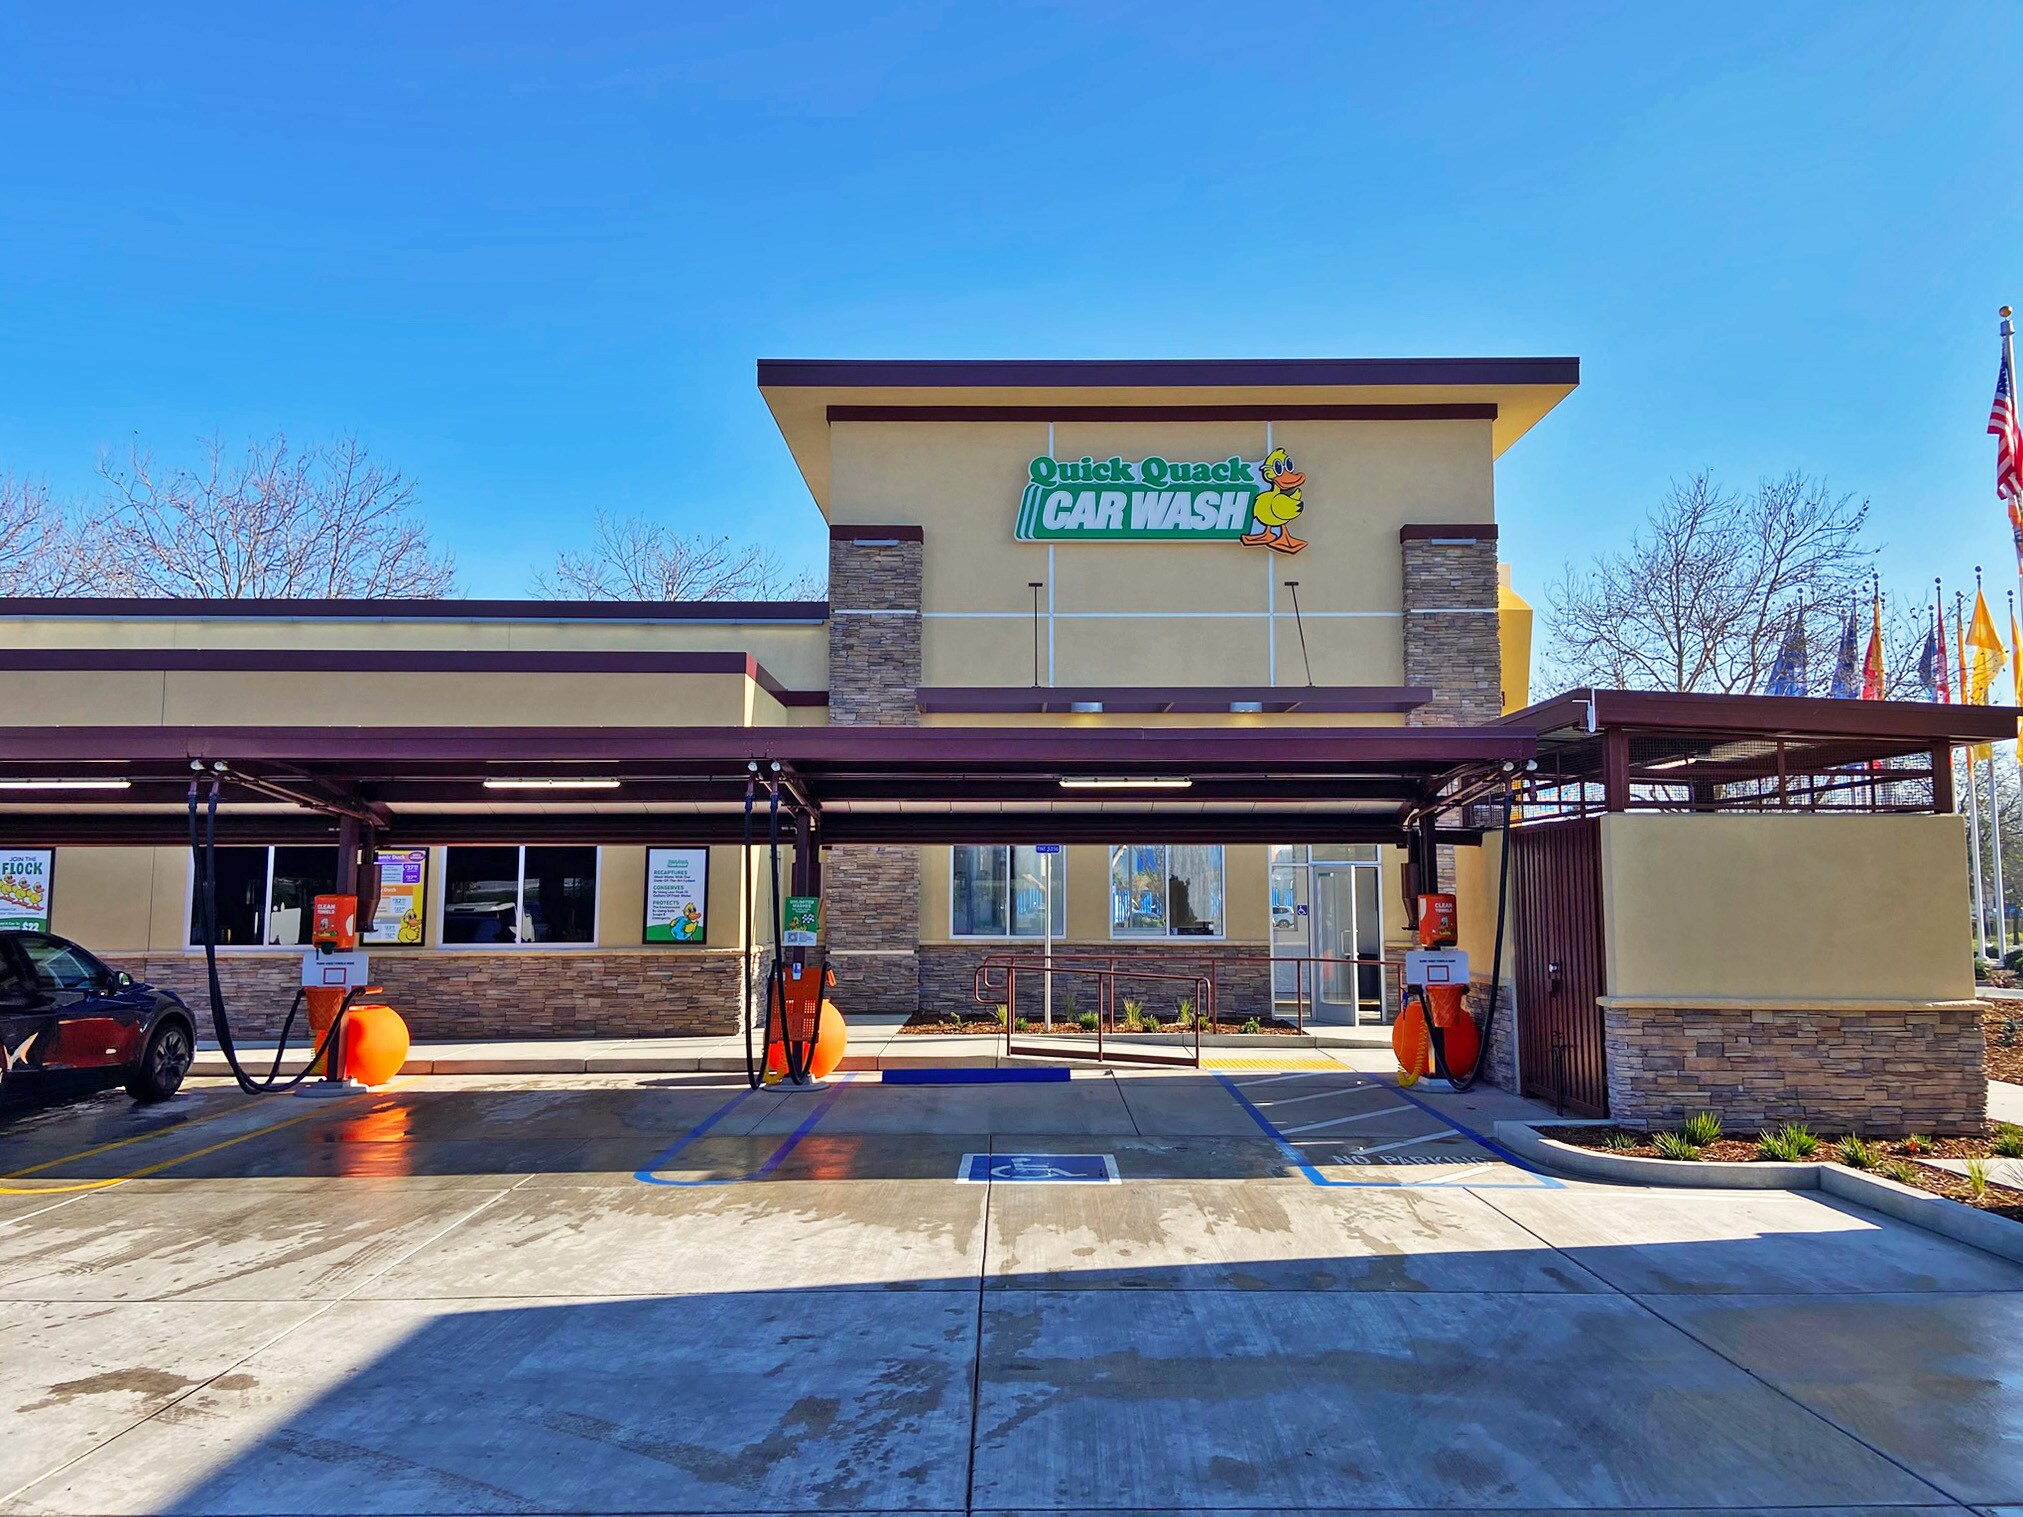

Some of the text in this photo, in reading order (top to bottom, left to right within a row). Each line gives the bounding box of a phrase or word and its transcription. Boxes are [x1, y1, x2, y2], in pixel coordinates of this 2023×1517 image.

[1030, 457, 1254, 487] Quick Quack
[1042, 491, 1250, 530] CAR WASH
[2, 862, 43, 875] FLOCK
[22, 921, 39, 931] $22
[1332, 1155, 1490, 1166] NO PARKING
